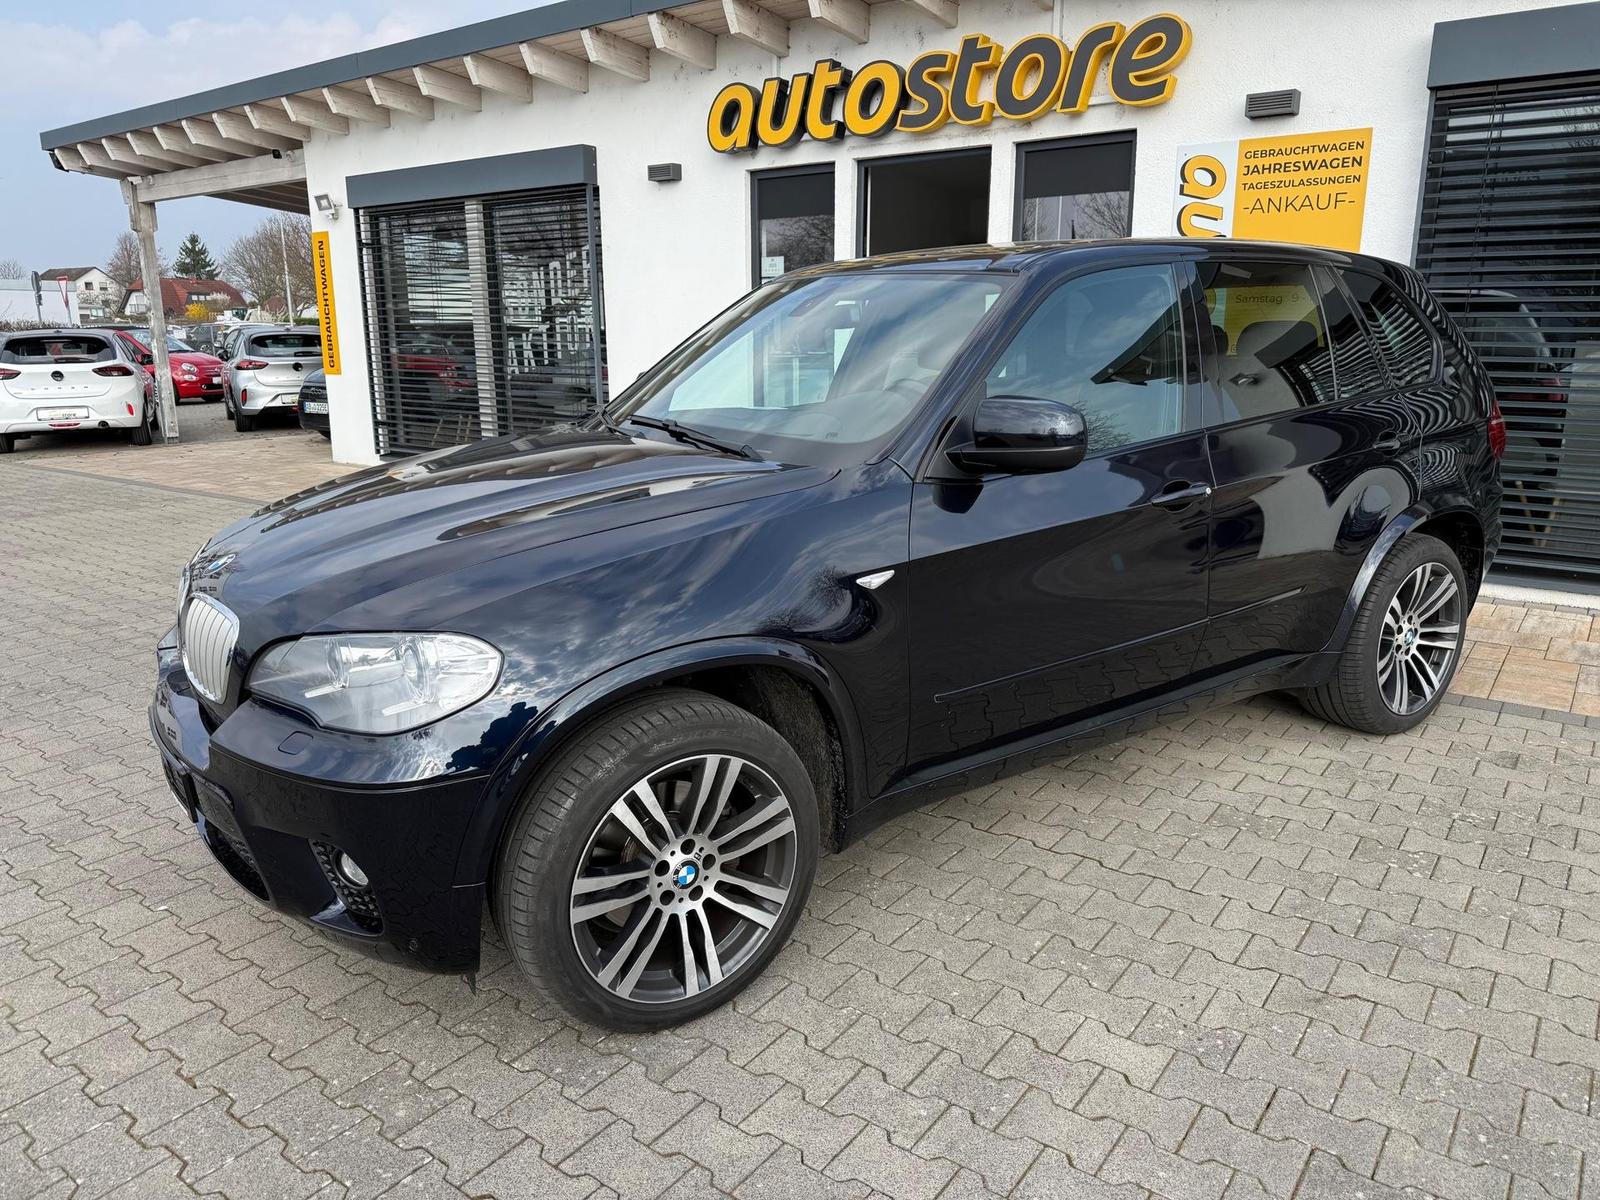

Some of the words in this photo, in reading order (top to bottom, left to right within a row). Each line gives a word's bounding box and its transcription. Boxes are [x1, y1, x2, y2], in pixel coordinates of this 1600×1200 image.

[707, 13, 1191, 153] autostore
[1244, 141, 1365, 160] GEBRAUCHTWAGEN
[1242, 156, 1363, 176] JAHRESWAGEN
[1242, 175, 1361, 191] TAGESZULASSUNGEN
[1243, 192, 1356, 215] -ANKAUF-
[318, 240, 334, 368] GEBRAUCHTWAGEN
[1235, 294, 1283, 305] Samstag
